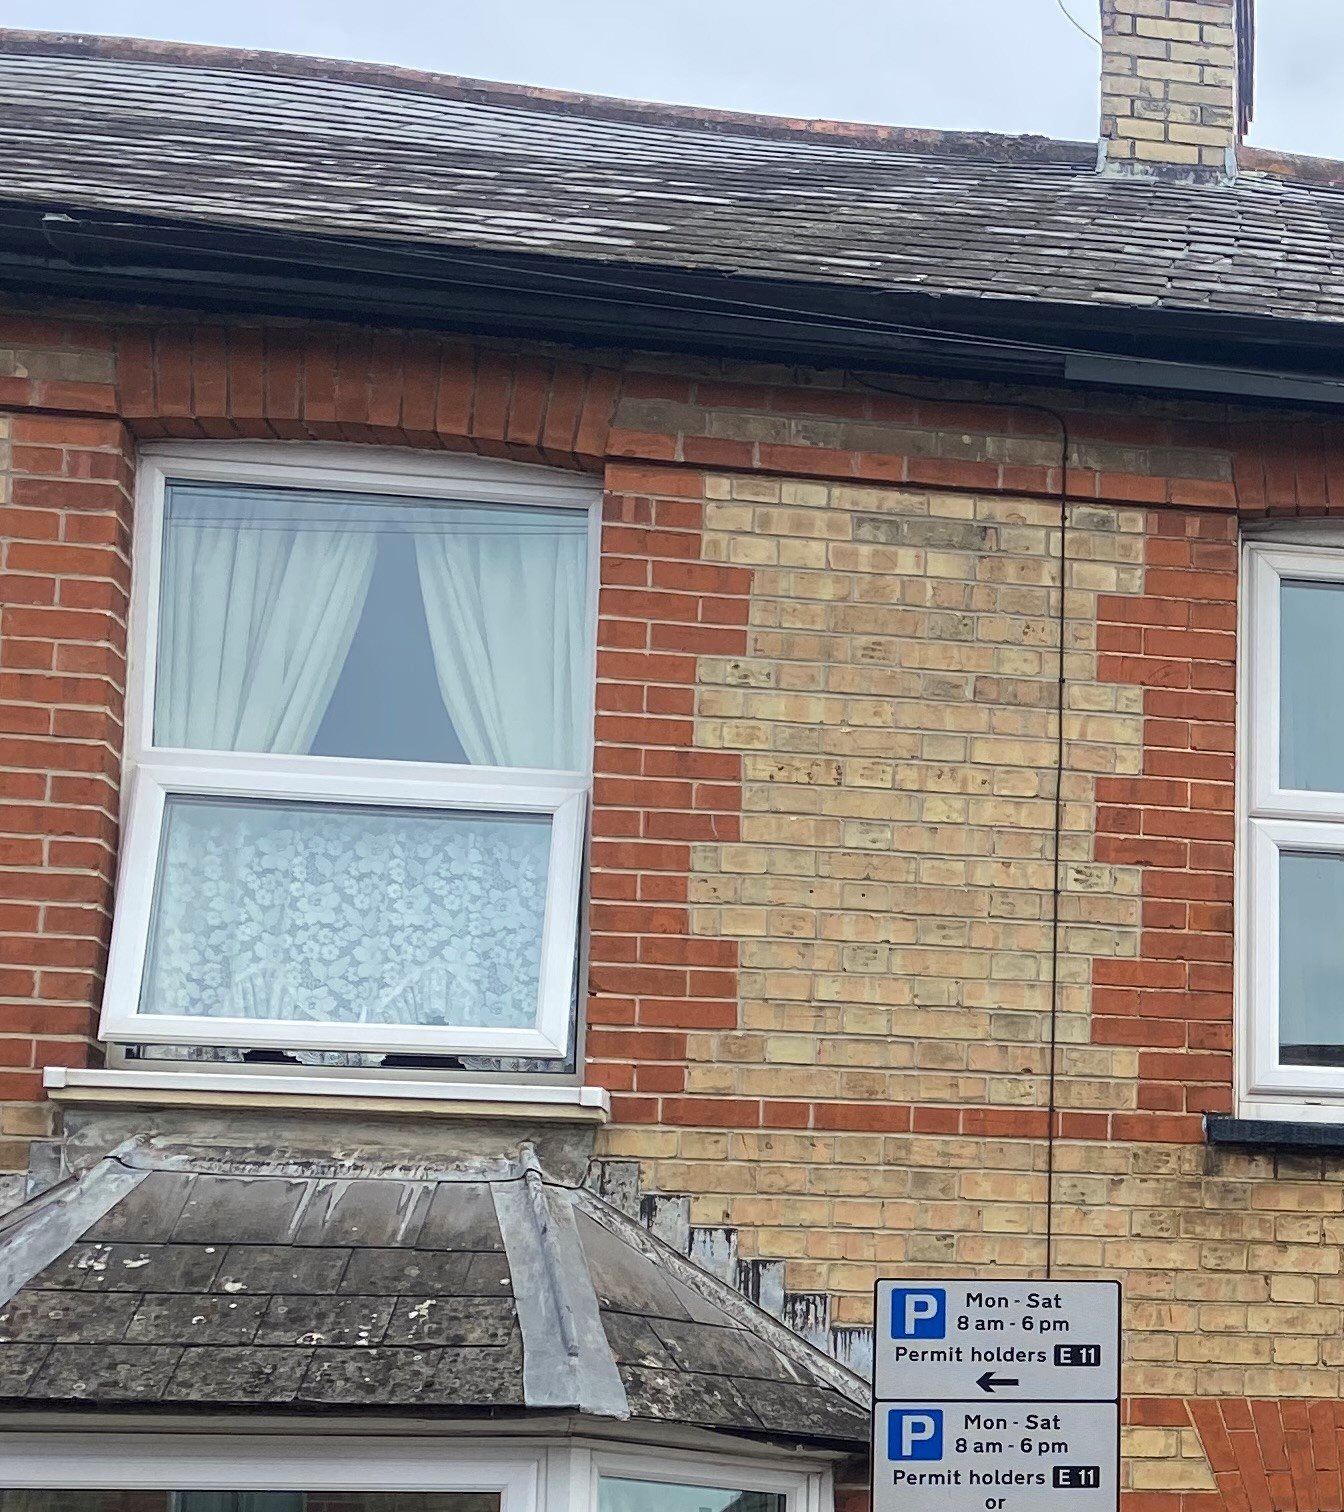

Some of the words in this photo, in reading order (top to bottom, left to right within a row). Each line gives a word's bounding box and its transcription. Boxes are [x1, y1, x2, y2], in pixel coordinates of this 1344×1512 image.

[966, 1293, 1008, 1308] Mon
[1026, 1293, 1061, 1308] Sat
[905, 1294, 937, 1334] P
[958, 1316, 968, 1330] 8
[975, 1320, 1003, 1330] am
[1022, 1316, 1033, 1330] 6
[1040, 1320, 1069, 1334] pm
[896, 1347, 962, 1362] Permit
[972, 1347, 1046, 1362] holders
[1060, 1347, 1072, 1364] E
[1079, 1347, 1095, 1364] 11
[965, 1415, 1006, 1429] Mon
[1025, 1415, 1060, 1430] Sat
[902, 1415, 934, 1455] P
[956, 1438, 967, 1453] 8
[974, 1442, 1002, 1453] am
[1021, 1438, 1032, 1453] 6
[1039, 1442, 1068, 1456] pm
[894, 1470, 961, 1485] Permit
[970, 1470, 1045, 1485] holders
[1059, 1469, 1071, 1485] E
[1078, 1469, 1094, 1485] 11
[986, 1498, 1006, 1509] or
